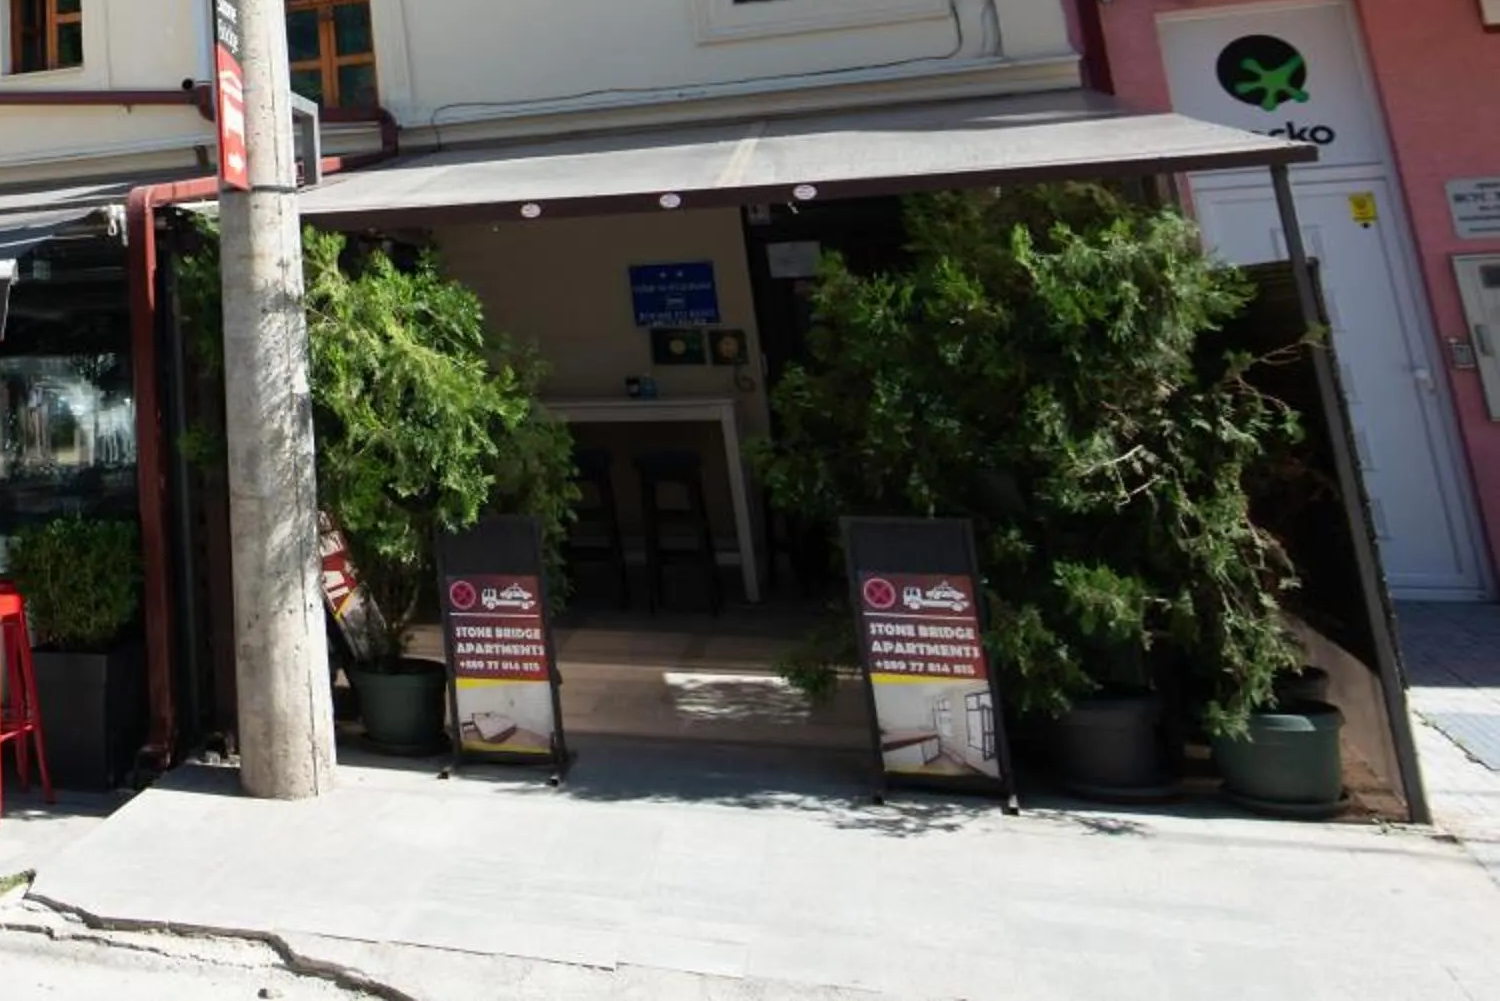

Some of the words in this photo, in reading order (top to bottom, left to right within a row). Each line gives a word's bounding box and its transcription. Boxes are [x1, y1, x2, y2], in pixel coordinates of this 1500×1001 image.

[455, 626, 493, 638] STONE
[495, 626, 541, 640] BRIDGE
[869, 622, 916, 637] STONE
[918, 624, 975, 640] BRIDGE
[456, 642, 545, 656] APARTMENTS
[871, 640, 980, 658] APARTMENTS
